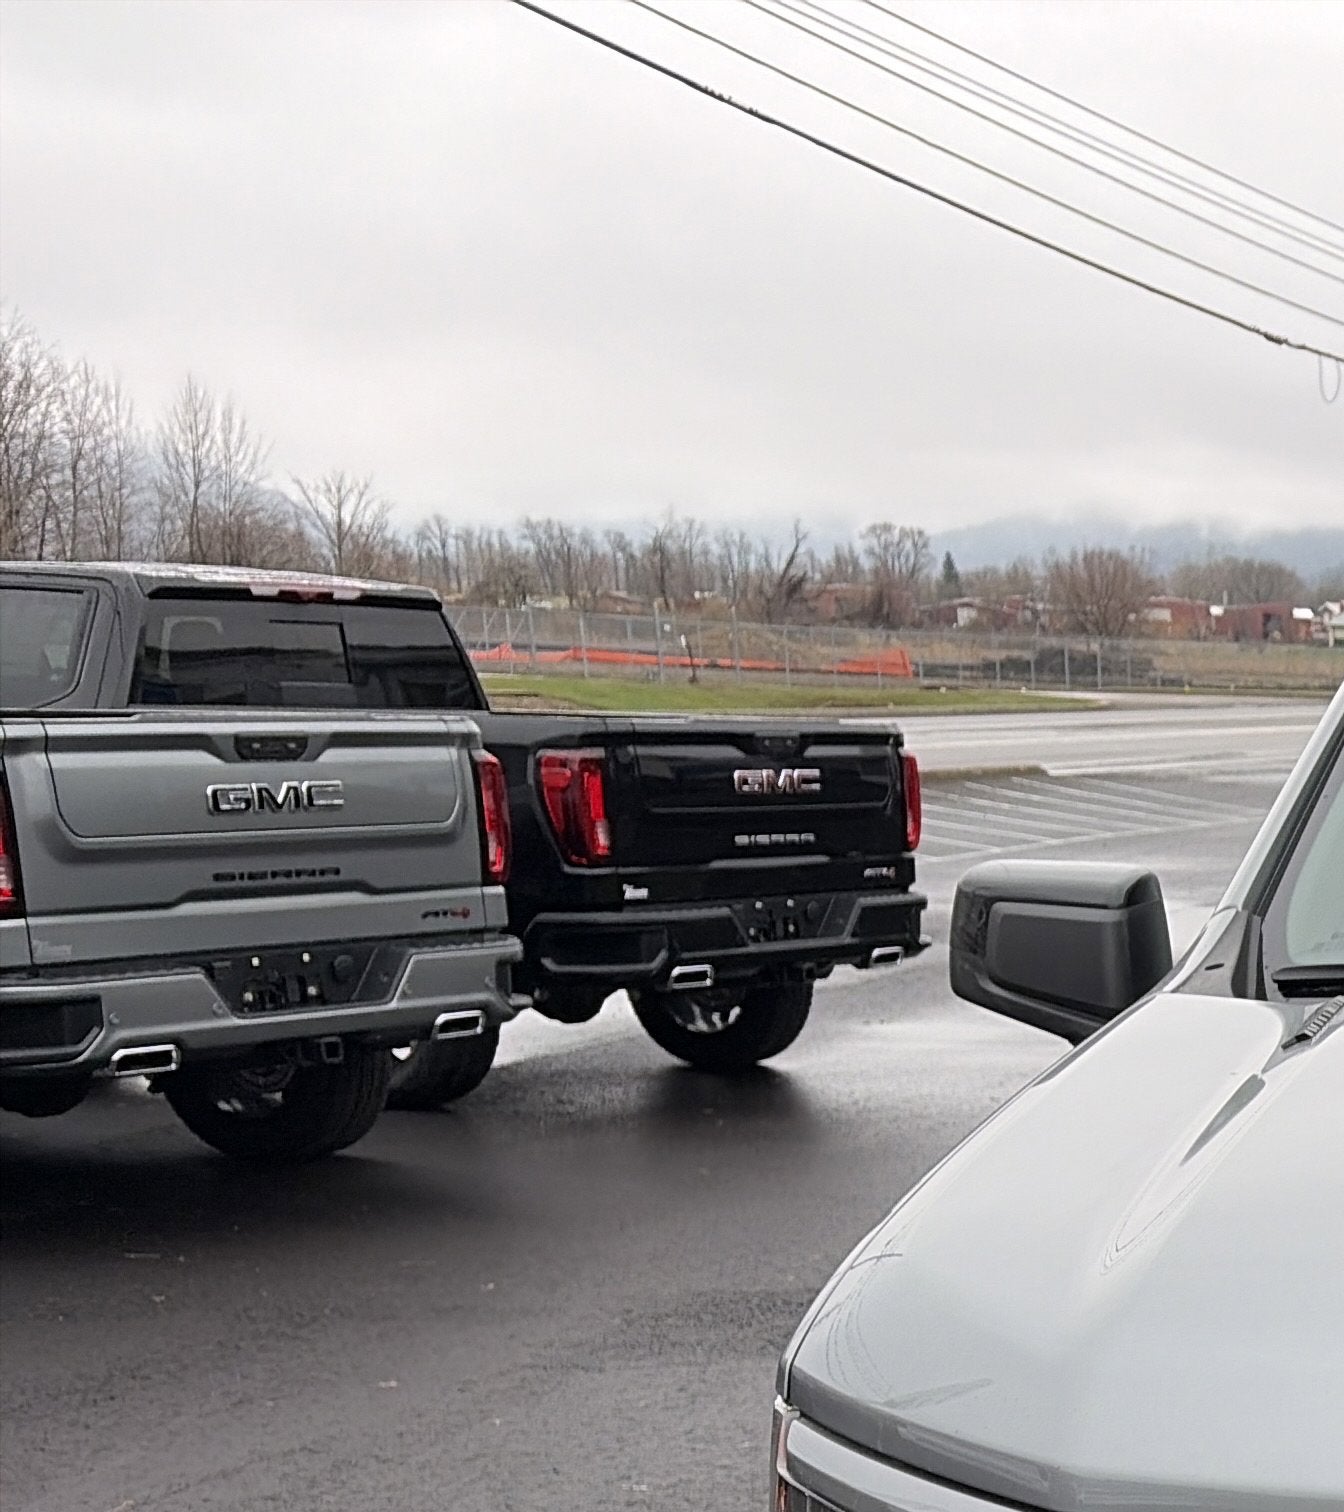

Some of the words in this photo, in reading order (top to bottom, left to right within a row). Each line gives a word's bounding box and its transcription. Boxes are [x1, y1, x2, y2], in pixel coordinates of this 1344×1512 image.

[733, 768, 822, 795] GMC
[206, 779, 344, 816] GMC
[212, 866, 340, 882] SIERRA
